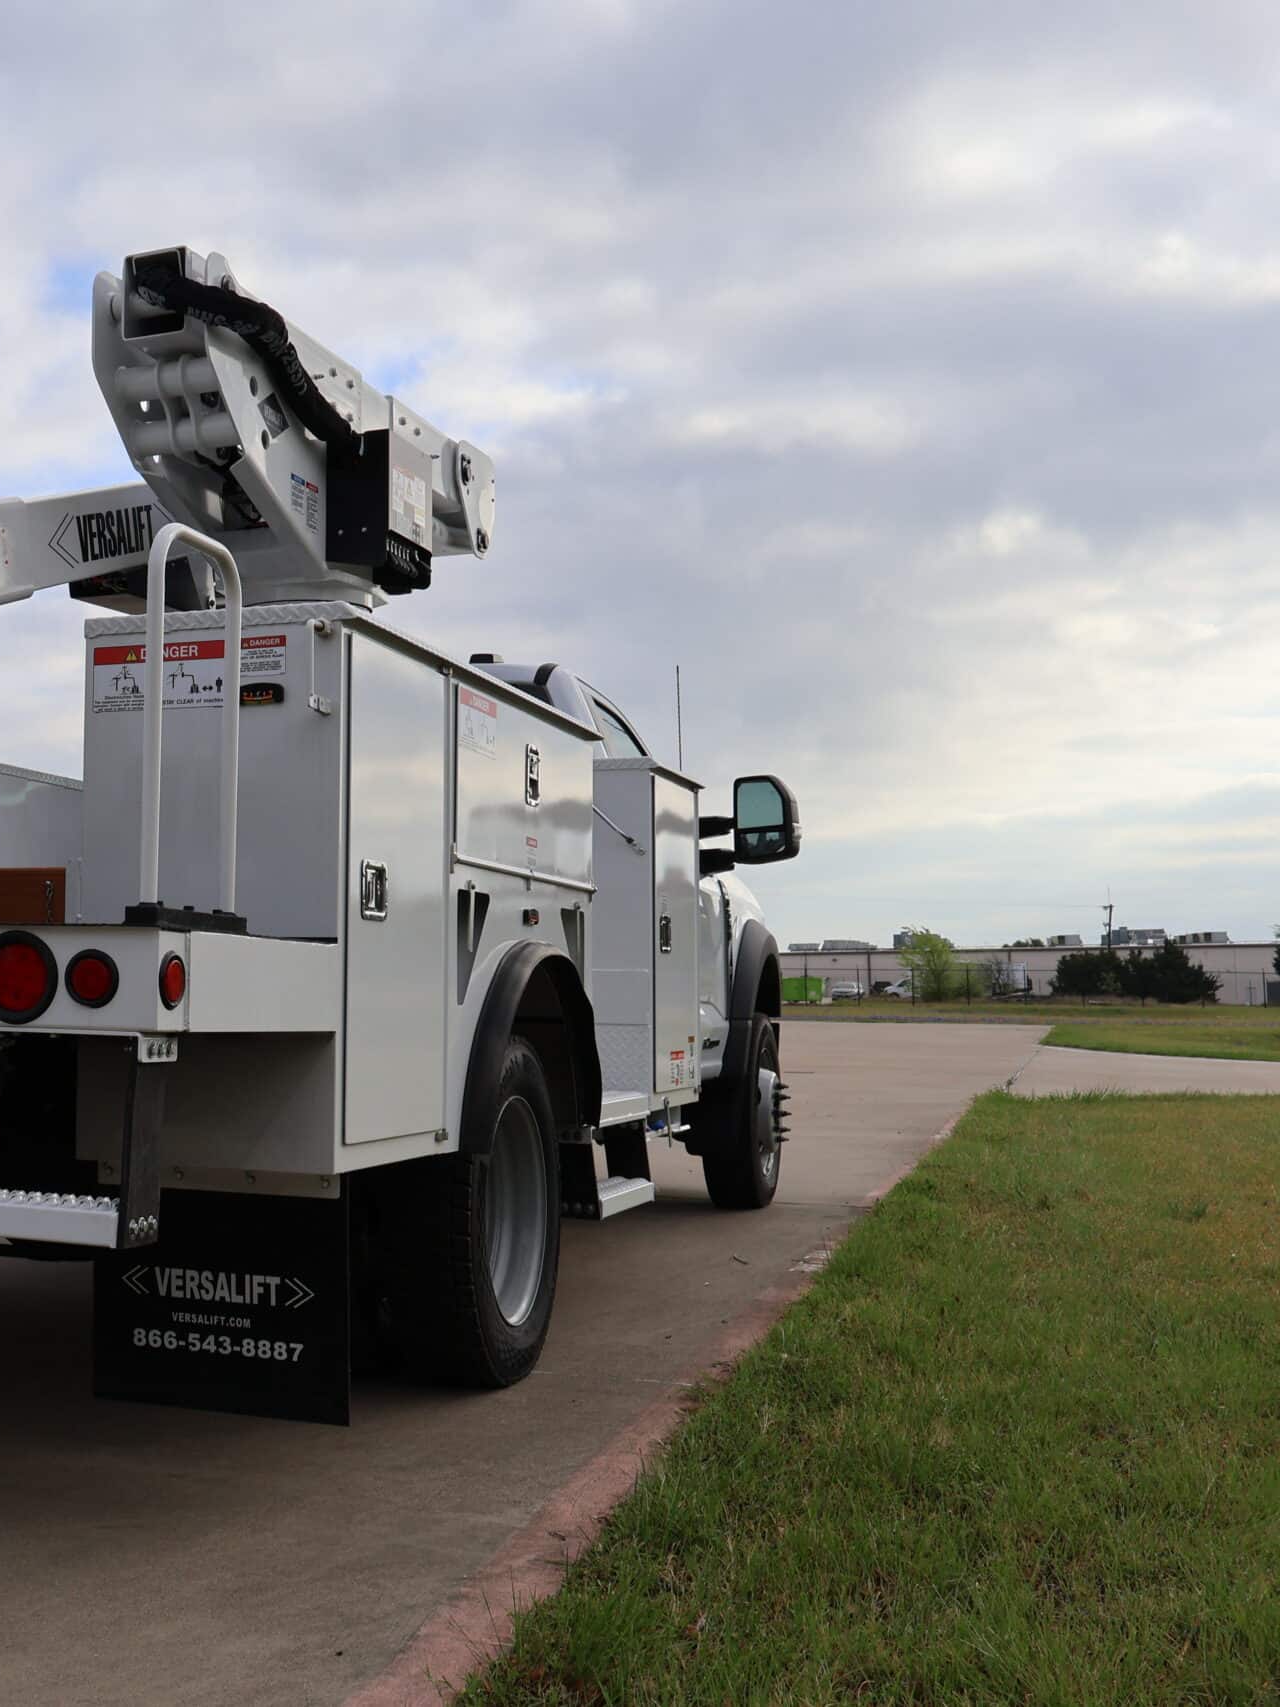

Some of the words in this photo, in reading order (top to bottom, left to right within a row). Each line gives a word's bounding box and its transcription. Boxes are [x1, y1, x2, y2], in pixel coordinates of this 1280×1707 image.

[76, 505, 153, 562] VERSALIFT
[140, 645, 198, 660] DNGER
[250, 638, 280, 647] DANGER
[155, 1266, 281, 1307] VERSALIFT
[171, 1311, 252, 1329] VERSALIFT.COM
[133, 1327, 305, 1362] 866-543-8887
